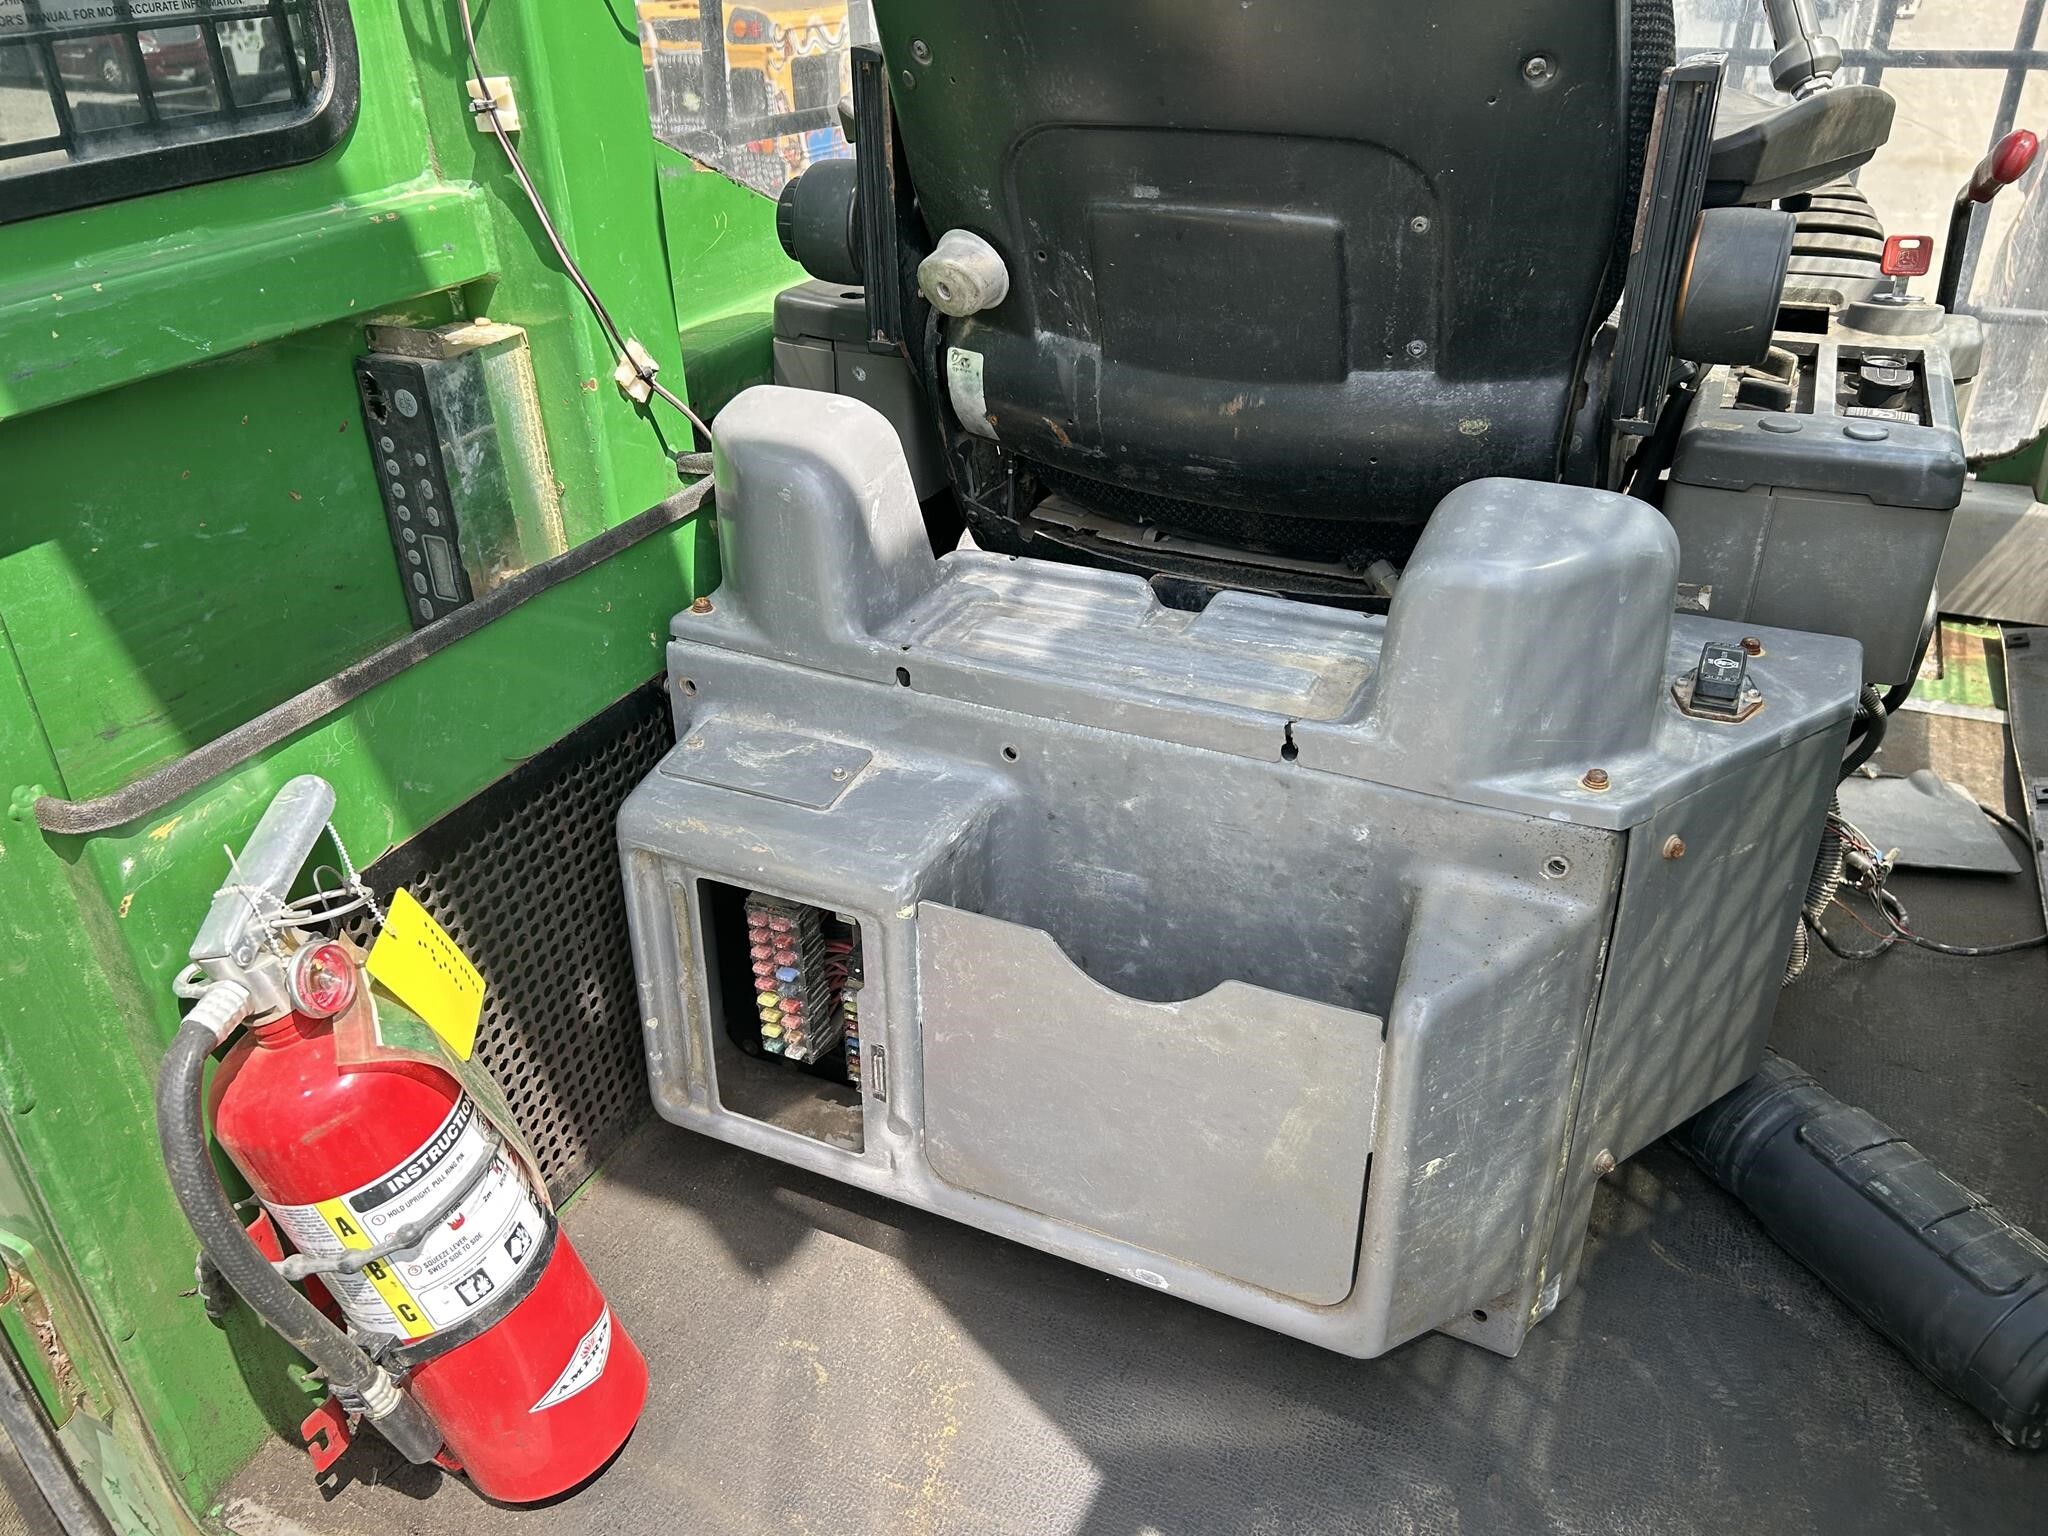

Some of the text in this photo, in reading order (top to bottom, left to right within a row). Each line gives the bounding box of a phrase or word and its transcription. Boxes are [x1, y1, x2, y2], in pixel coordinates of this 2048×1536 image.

[73, 8, 96, 20] FOR
[97, 5, 126, 17] MORE
[129, 1, 179, 14] ACCURATE
[387, 1205, 405, 1218] HOLD
[431, 1174, 447, 1189] PULL
[445, 1162, 458, 1176] RING
[456, 1151, 465, 1164] PIN
[335, 1216, 357, 1237] A
[423, 1248, 450, 1269] SQUEEZE
[449, 1235, 468, 1257] LEVER
[427, 1258, 448, 1275] SWEEP
[448, 1249, 464, 1265] SIDE
[462, 1241, 472, 1253] TO
[470, 1231, 483, 1246] SIDE
[366, 1261, 387, 1281] B
[397, 1303, 418, 1322] C
